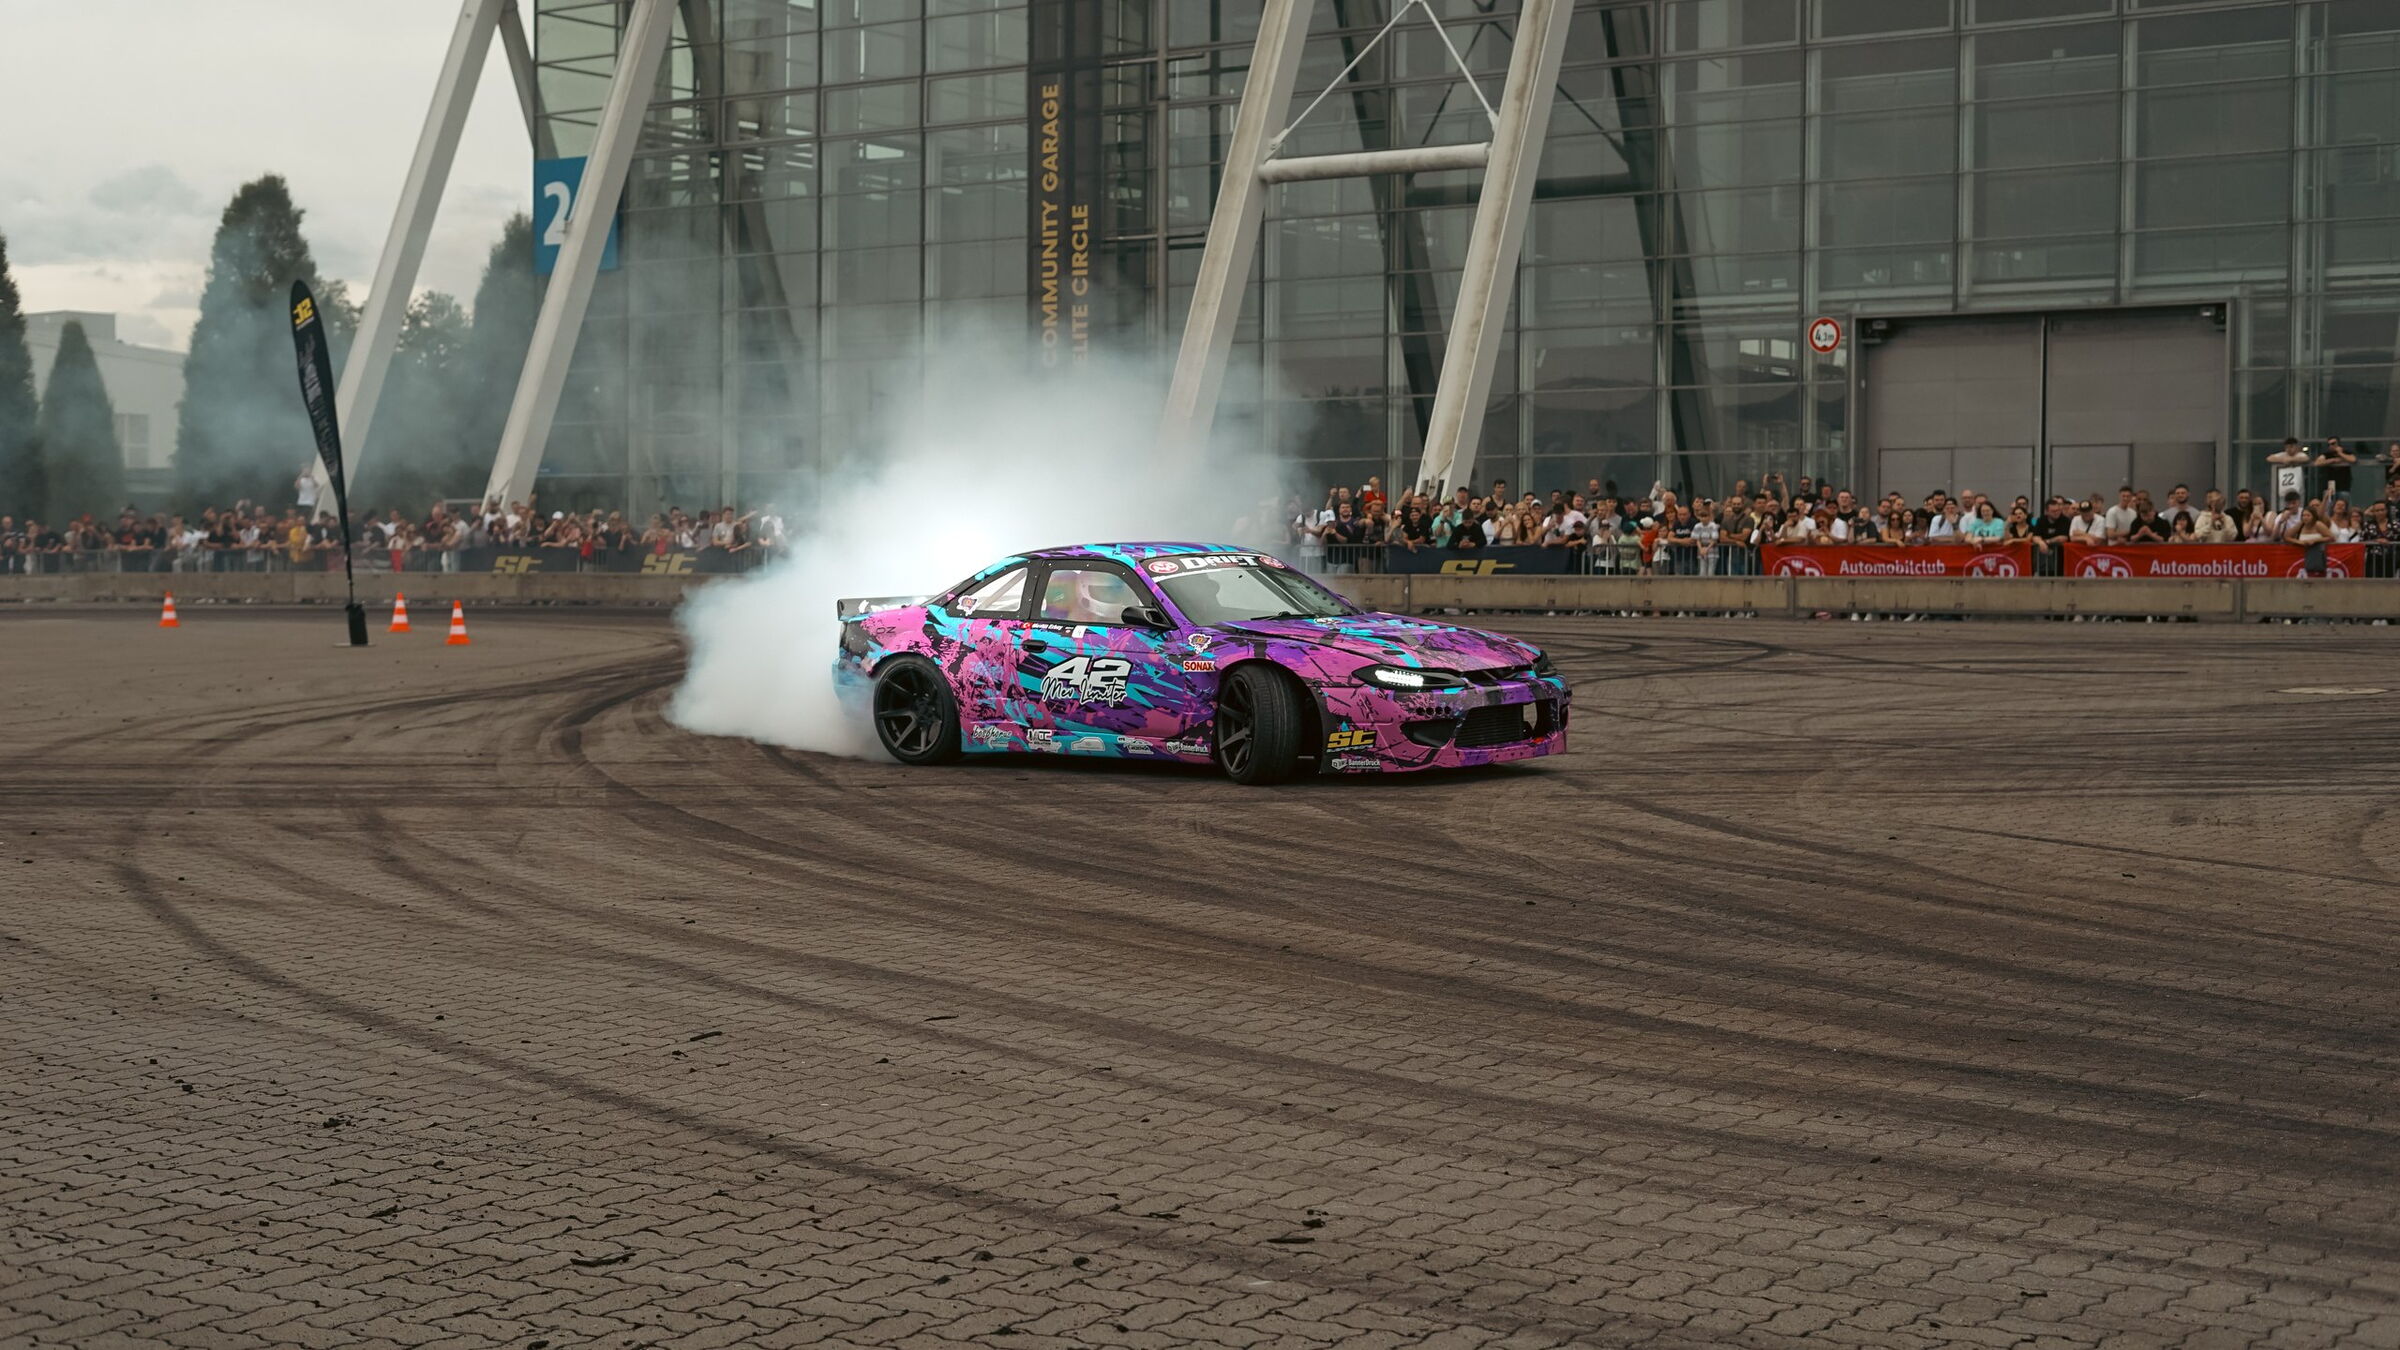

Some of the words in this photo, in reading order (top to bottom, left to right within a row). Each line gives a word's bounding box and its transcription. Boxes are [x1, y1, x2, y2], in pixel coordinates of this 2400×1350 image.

[1041, 83, 1060, 192] GARAGE
[1071, 204, 1089, 296] CIRCLE
[1041, 200, 1060, 367] COMMUNITY
[1071, 303, 1089, 366] ELITE
[1180, 555, 1259, 570] DRIFT
[1839, 559, 1945, 575] Automobilclub
[2150, 559, 2268, 576] Automobilclub
[1047, 656, 1132, 688] 42
[1184, 661, 1214, 671] SONAX
[1080, 677, 1127, 707] Limiter
